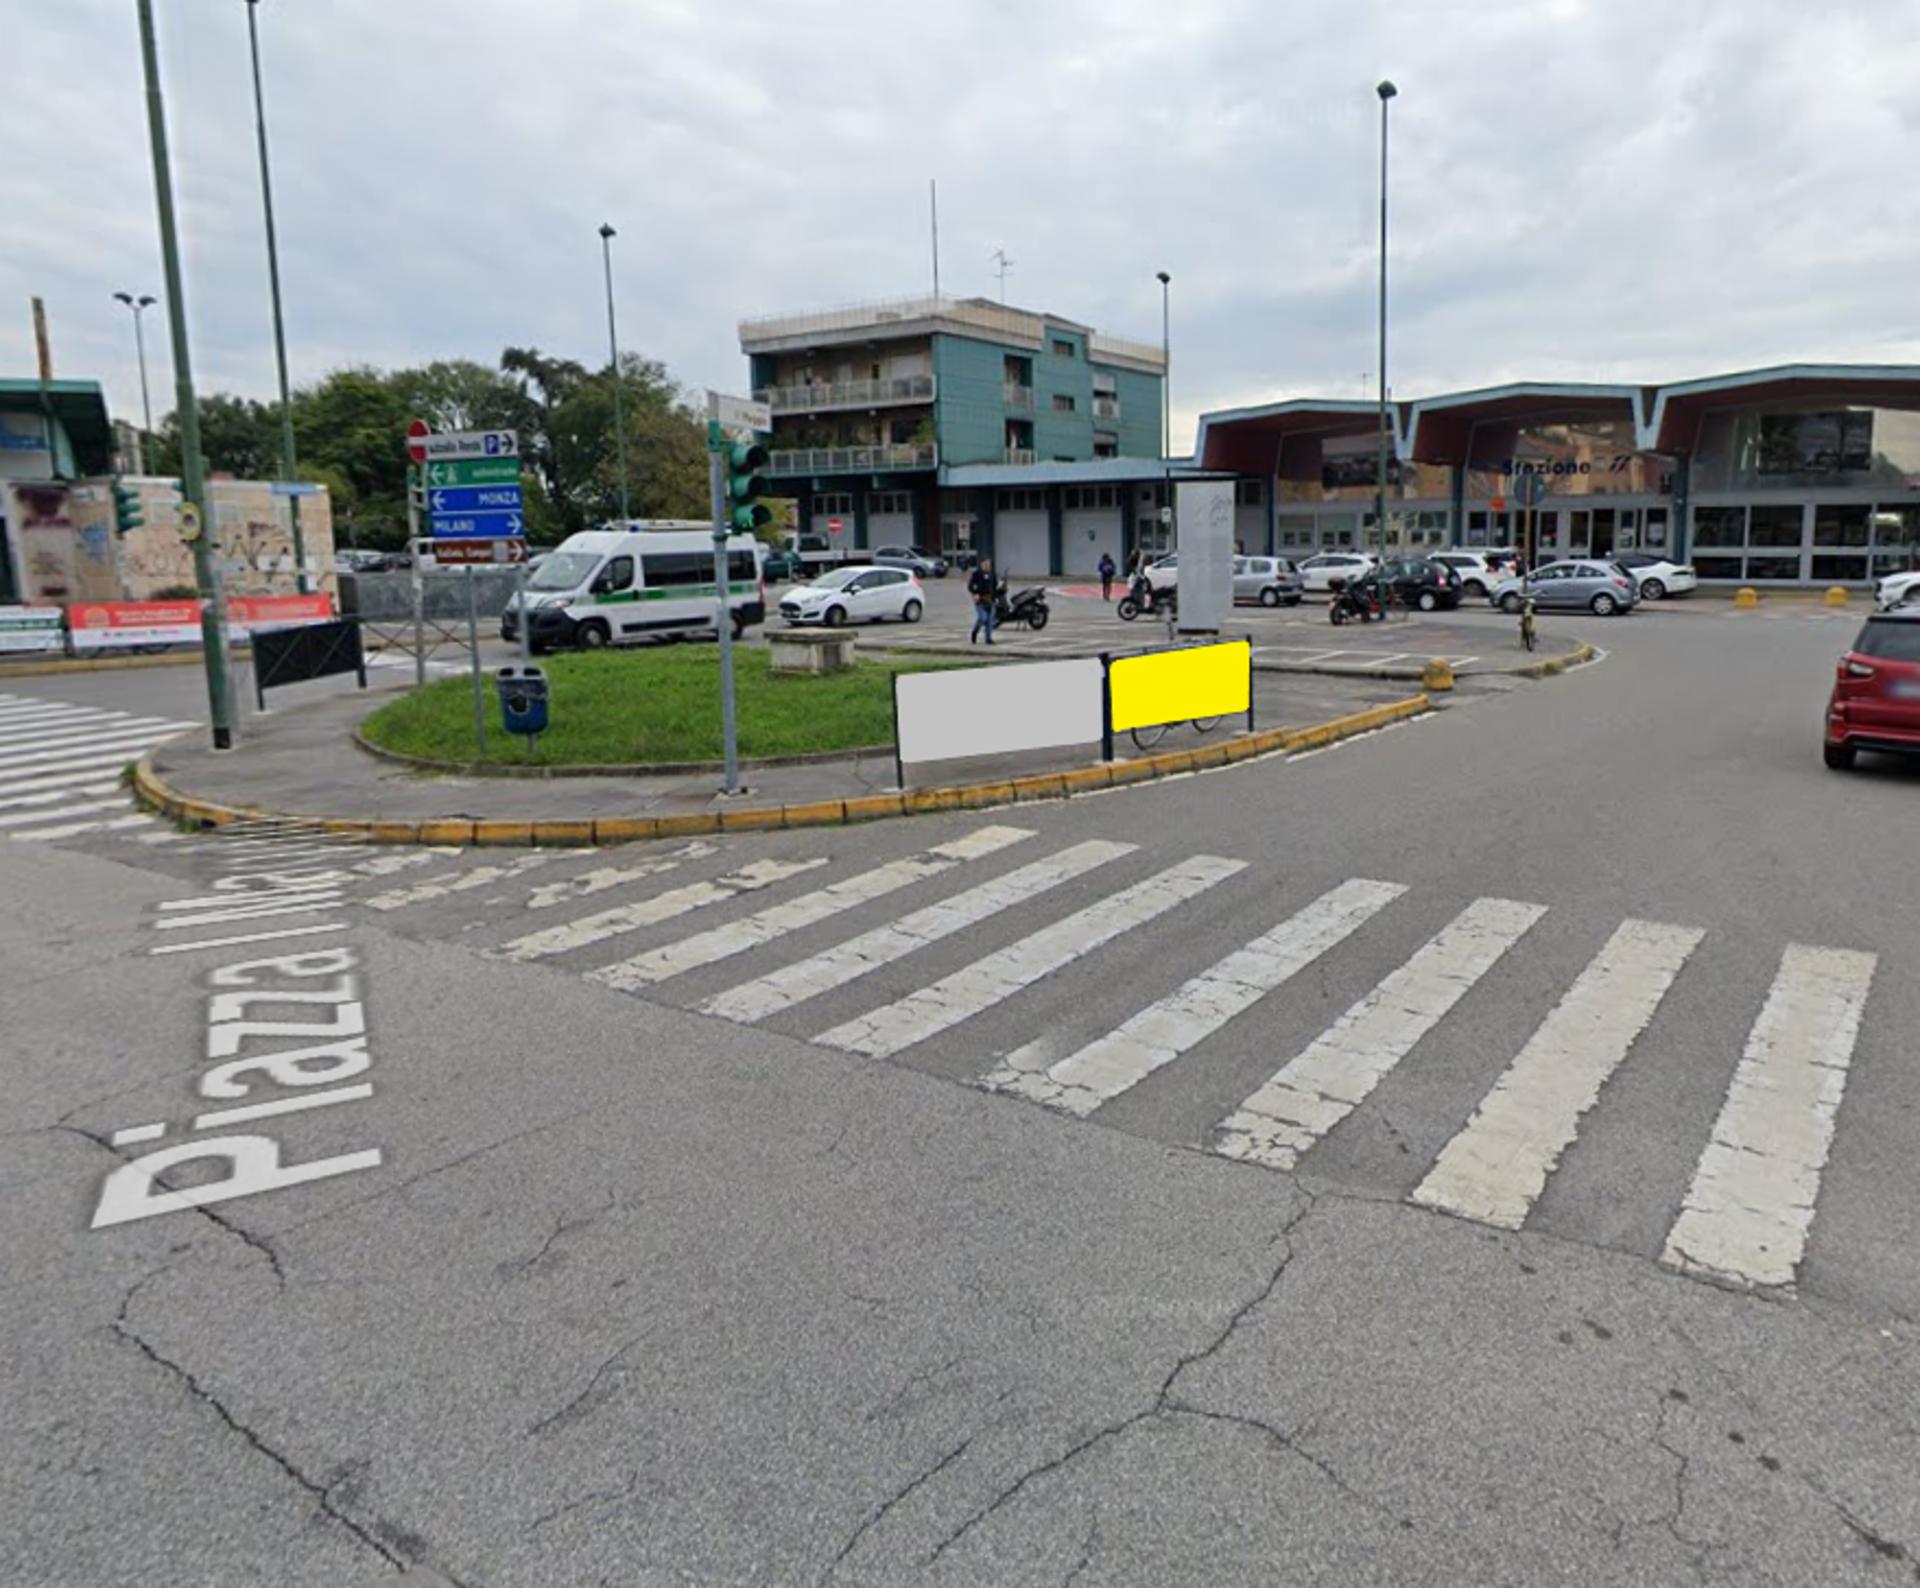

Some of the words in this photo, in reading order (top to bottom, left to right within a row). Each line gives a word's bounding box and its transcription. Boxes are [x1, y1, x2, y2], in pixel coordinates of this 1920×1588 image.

[1503, 456, 1590, 476] Stazione
[478, 490, 519, 506] MONZA
[433, 519, 475, 532] MILANO
